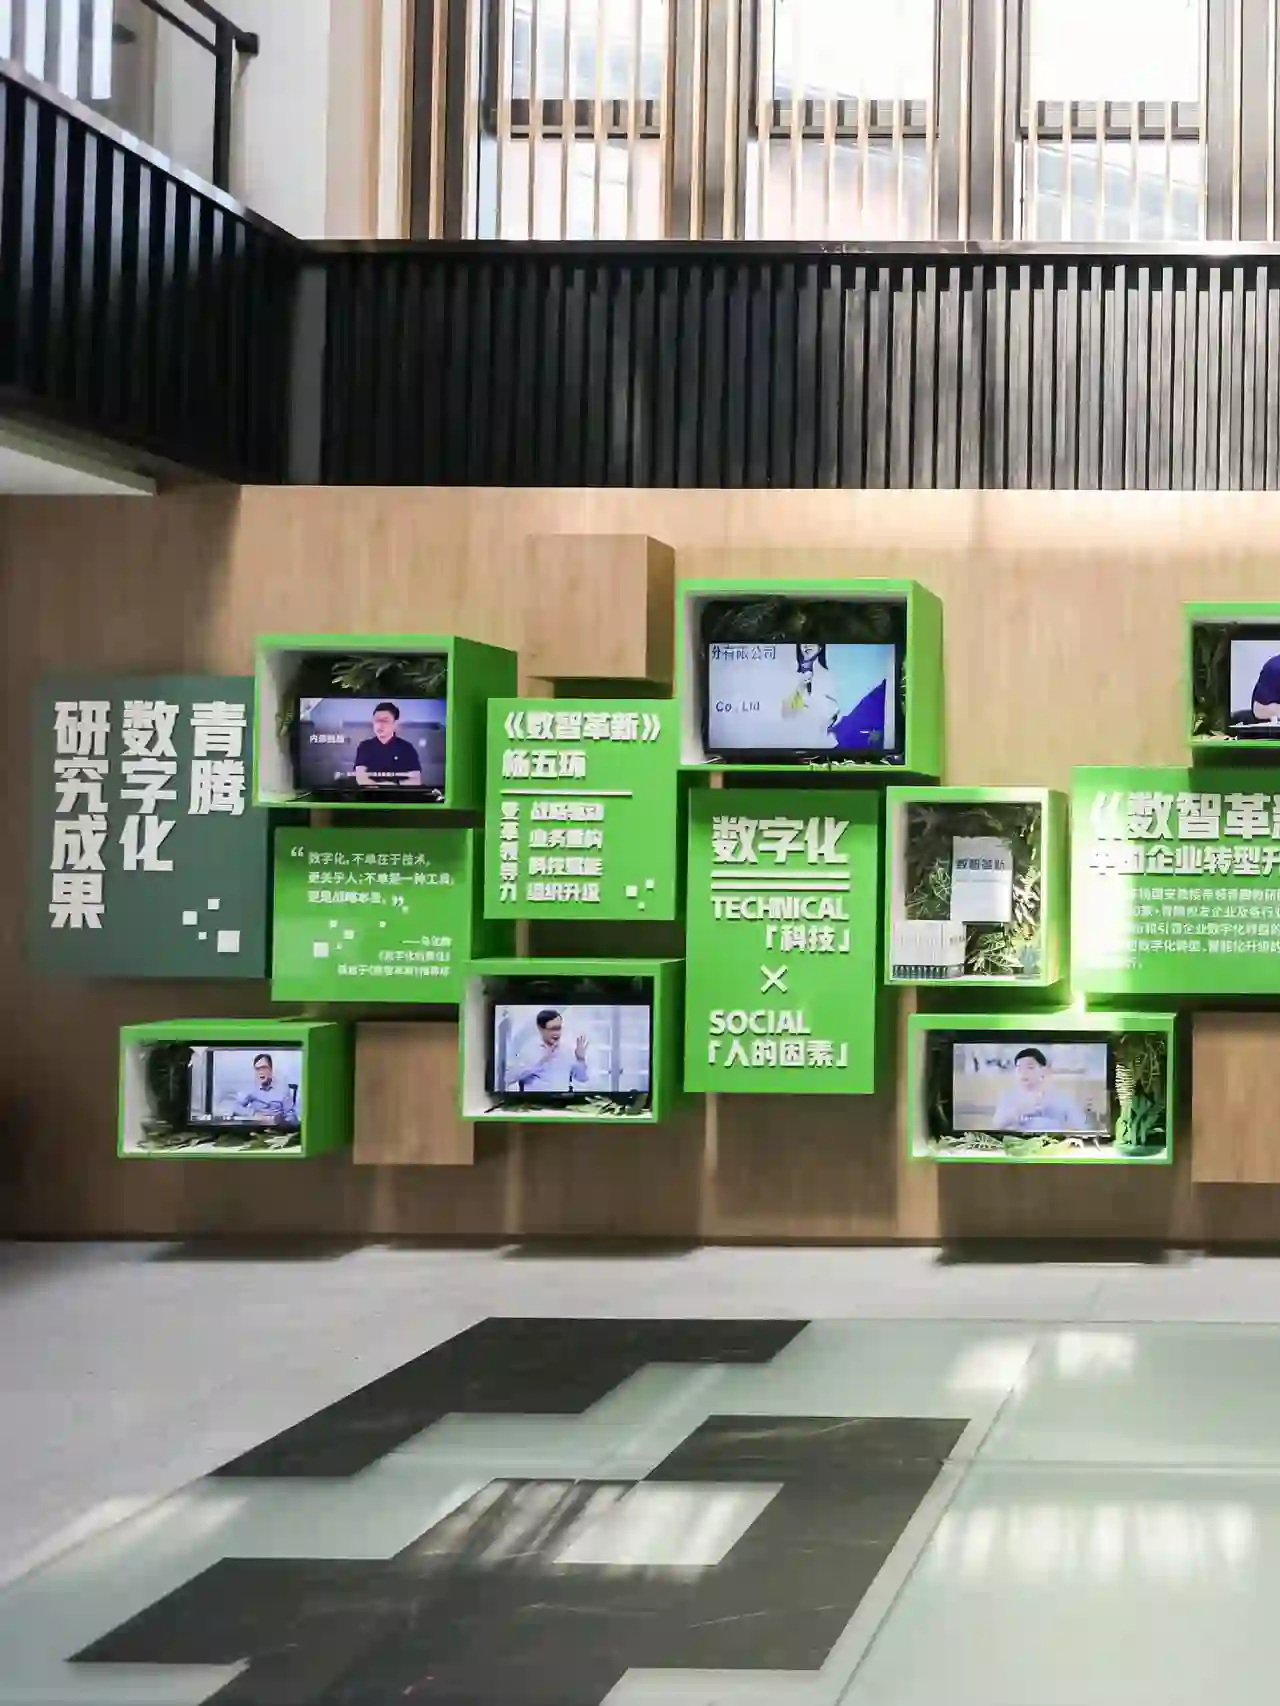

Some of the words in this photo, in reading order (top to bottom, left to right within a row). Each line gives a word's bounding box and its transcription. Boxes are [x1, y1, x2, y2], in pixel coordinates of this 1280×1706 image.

[190, 701, 246, 816] 青腾
[121, 701, 179, 872] 数字化
[50, 701, 110, 929] 研究成果
[712, 815, 850, 864] 数字化
[711, 896, 850, 921] TECHNICAL
[765, 923, 850, 952] 「科技」
[708, 1009, 811, 1036] SOCIAL
[707, 1039, 849, 1068] 「人的因素」
